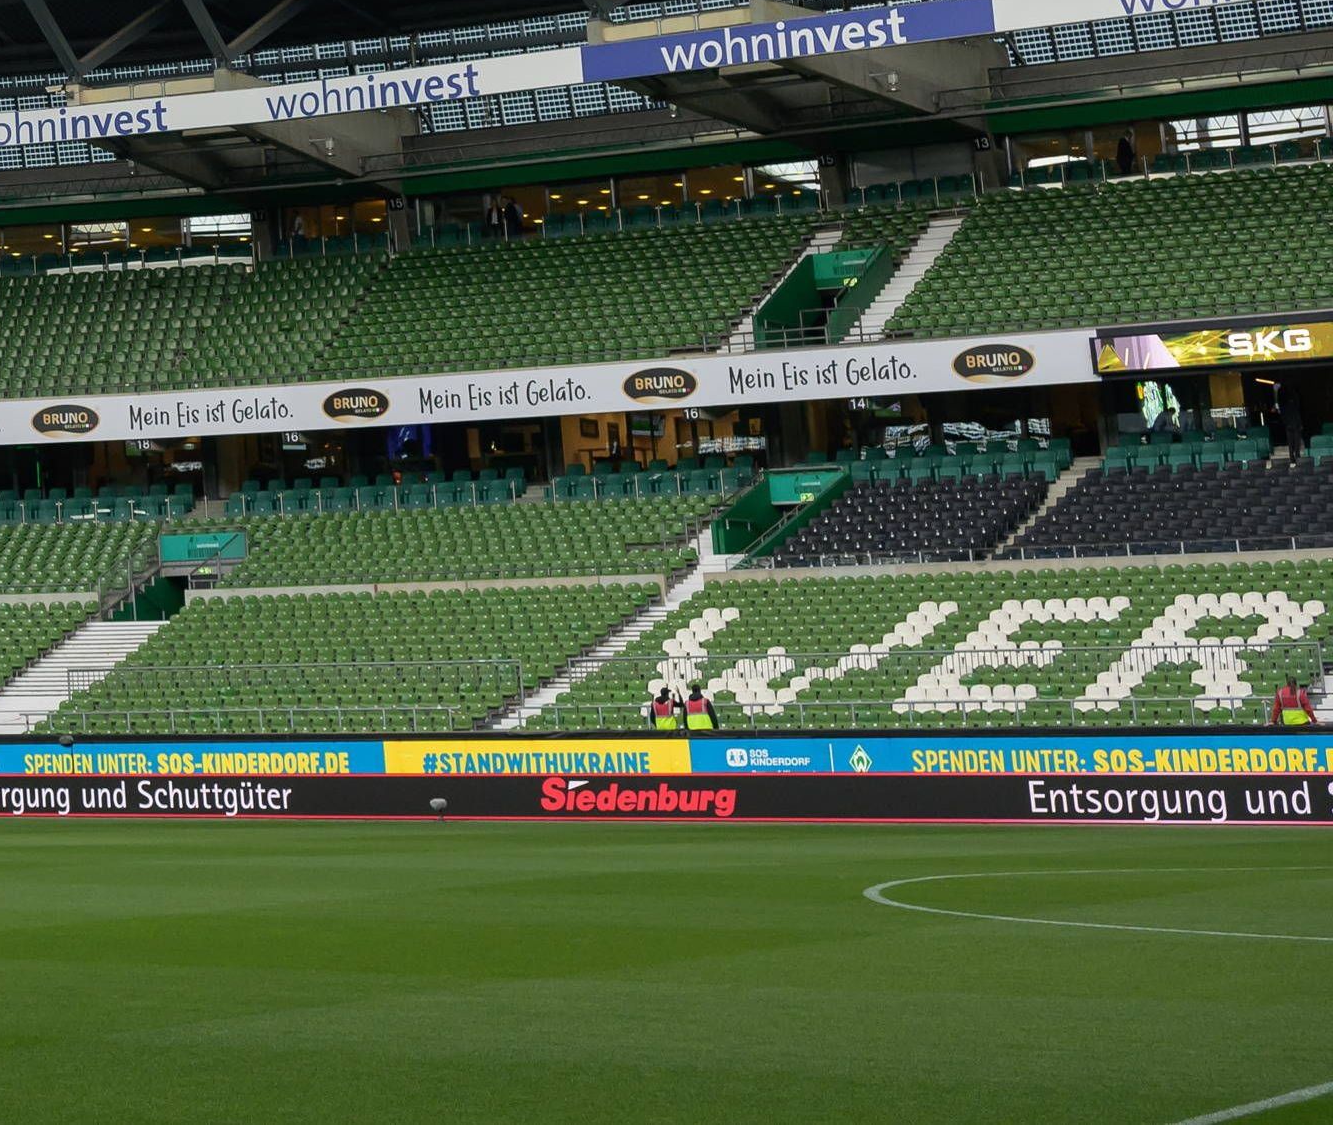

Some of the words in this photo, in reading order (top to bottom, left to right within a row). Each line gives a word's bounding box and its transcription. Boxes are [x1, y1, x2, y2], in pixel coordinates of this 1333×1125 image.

[661, 8, 907, 73] wohninvest
[265, 62, 481, 119] wohninvest
[975, 137, 989, 150] 13
[390, 198, 403, 209] 15
[1228, 329, 1311, 356] SKG
[966, 352, 1020, 369] BRUNO
[635, 376, 685, 390] BRUNO
[729, 368, 774, 394] Mein
[783, 364, 808, 389] Eis
[815, 360, 838, 385] ist
[846, 354, 917, 385] Gelato.
[334, 395, 378, 410] BRUNO
[419, 388, 461, 414] Mein
[469, 384, 492, 410] Eis
[499, 381, 520, 406] ist
[526, 378, 591, 406] Gelato.
[850, 398, 866, 409] 14
[43, 412, 88, 425] BRUNO
[129, 406, 170, 431] Mein
[177, 402, 199, 428] Eis
[206, 400, 226, 424] ist
[233, 397, 294, 423] Gelato.
[684, 408, 698, 419] 16
[285, 433, 299, 442] 16
[24, 753, 92, 774] SPENDEN
[99, 753, 153, 774] UNTER:
[157, 752, 350, 774] SOS-KINDERDORF.DE
[423, 751, 650, 774] #STANDWITHUKRAINE
[749, 749, 768, 757] SOS
[750, 757, 811, 766] KINDERDORF
[912, 749, 1004, 773] SPENDEN
[1011, 749, 1086, 773] UNTER:
[83, 780, 127, 809] und
[138, 780, 292, 817] Schuttgüter
[540, 777, 737, 817] Siedenburg
[1028, 780, 1228, 823] Entsorgung
[1244, 780, 1312, 814] und
